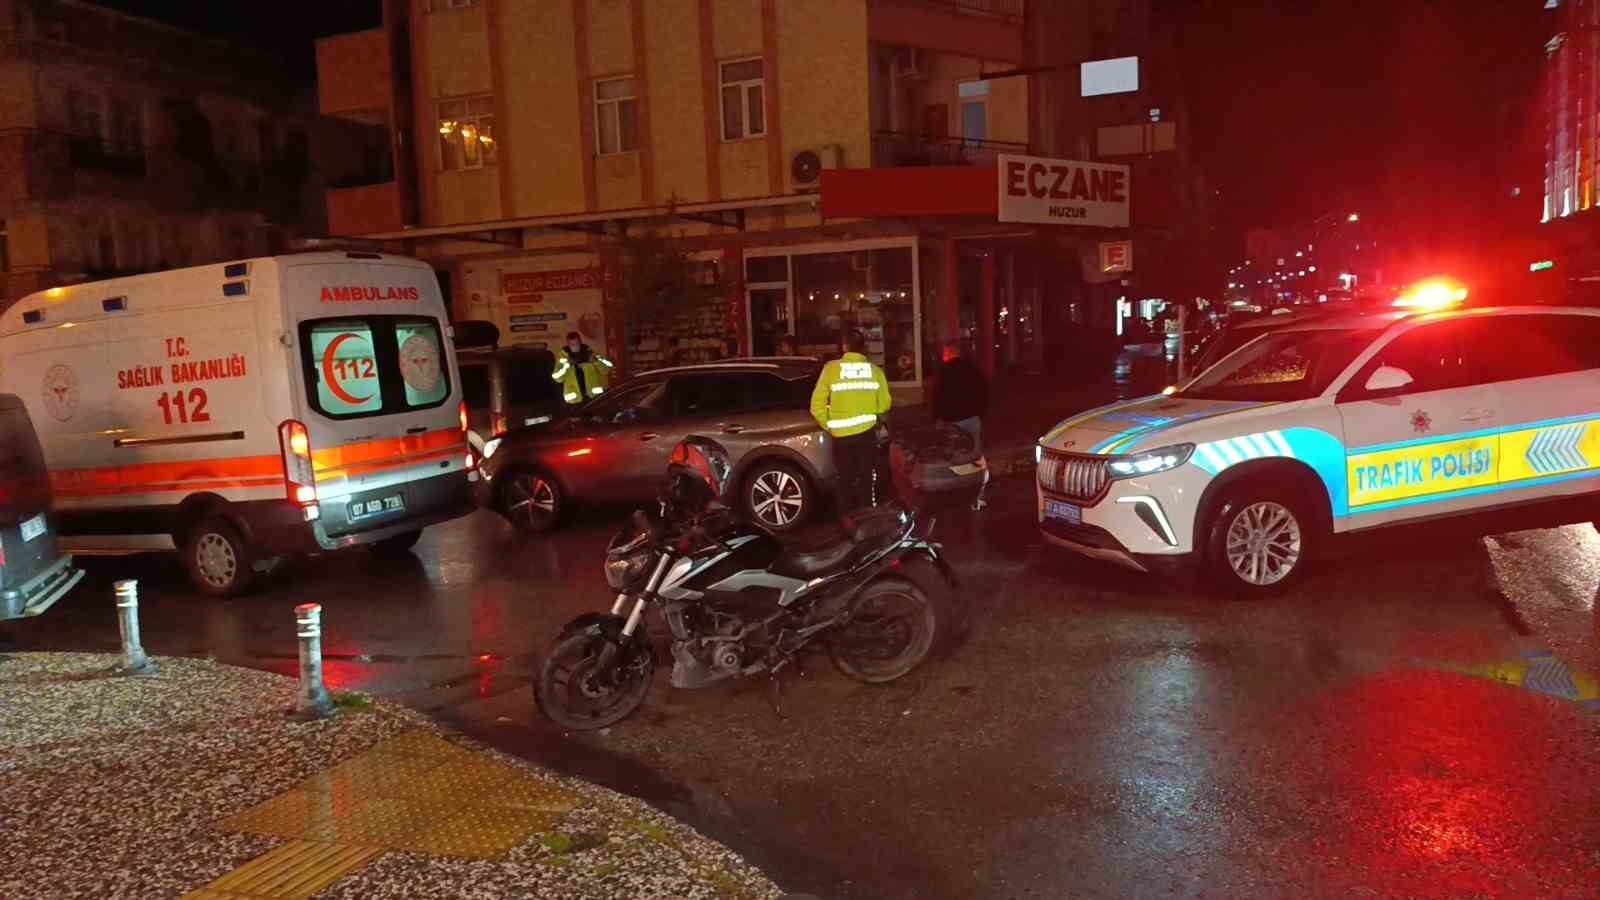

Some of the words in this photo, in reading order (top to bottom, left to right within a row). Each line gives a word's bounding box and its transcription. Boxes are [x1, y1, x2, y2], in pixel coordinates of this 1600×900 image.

[1007, 161, 1125, 203] ECZANE
[1048, 206, 1087, 219] HUZUR
[320, 286, 419, 303] AMBULANS
[165, 337, 190, 357] T.C.
[118, 364, 164, 389] SAĞLIK
[171, 353, 246, 384] BAKANLIĞI
[334, 358, 376, 380] 112
[157, 388, 211, 425] 112
